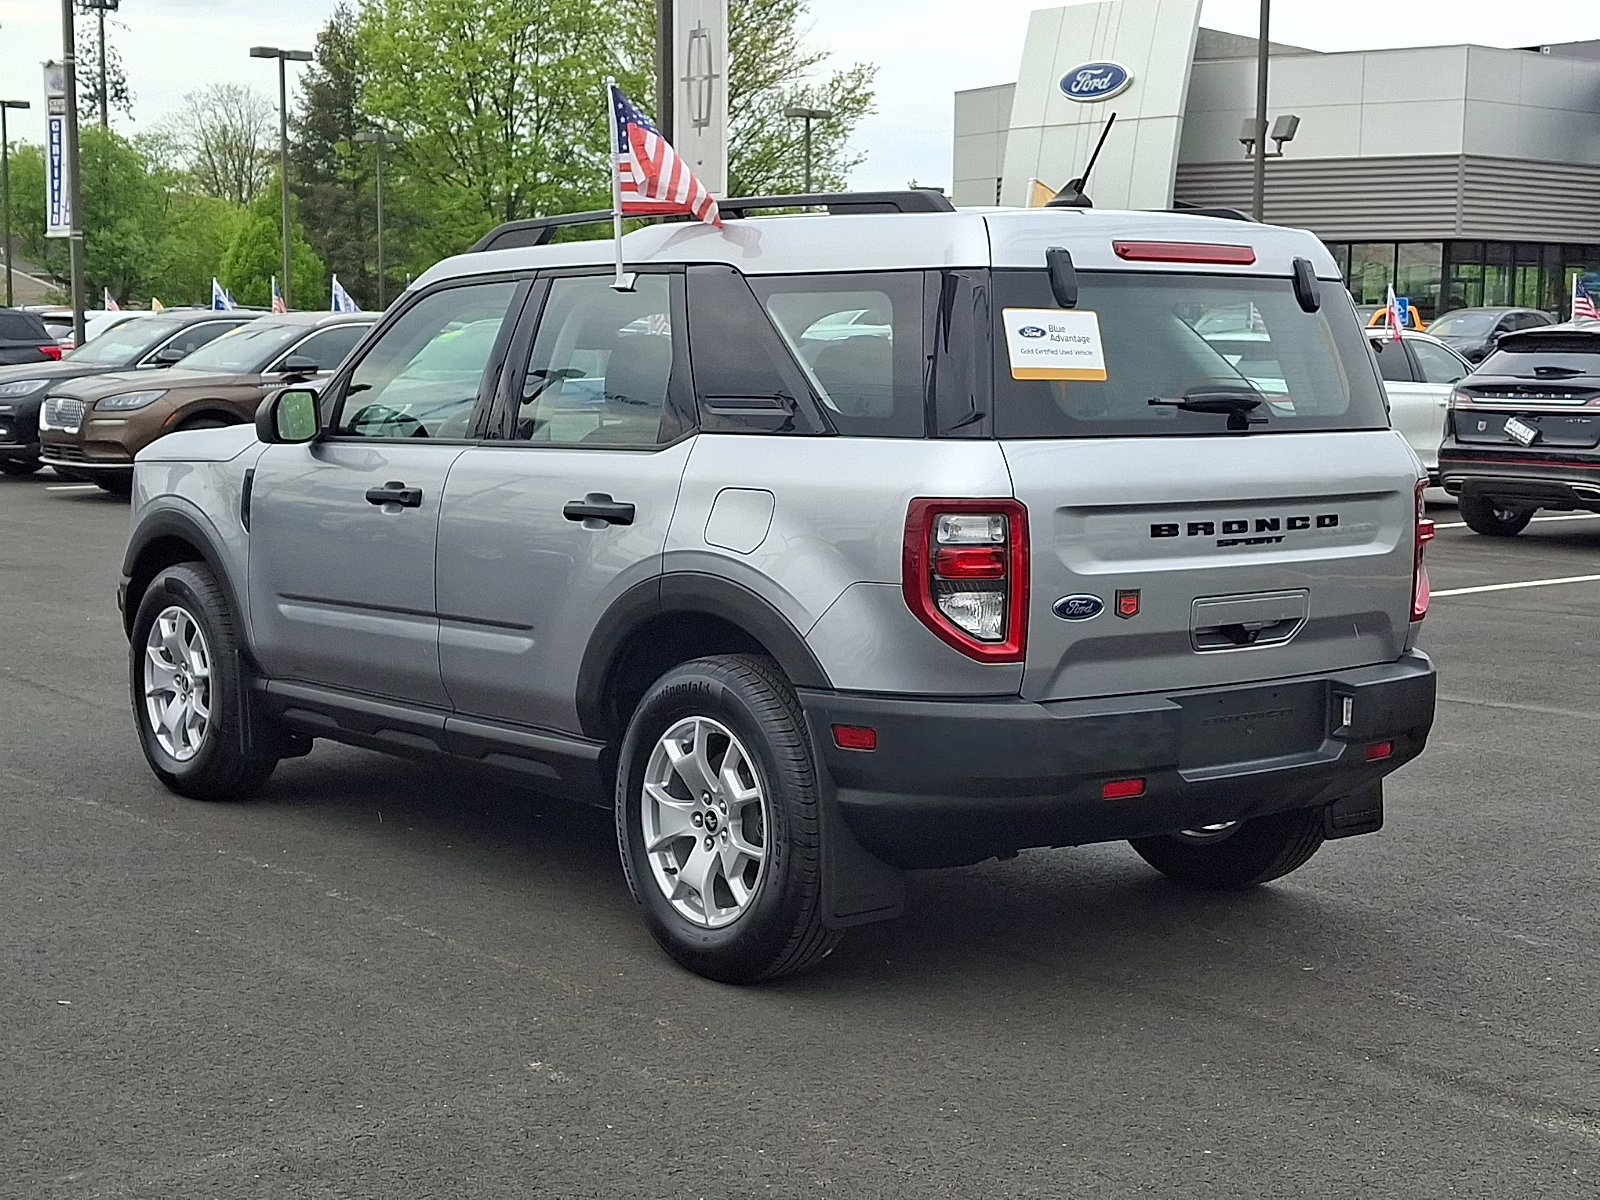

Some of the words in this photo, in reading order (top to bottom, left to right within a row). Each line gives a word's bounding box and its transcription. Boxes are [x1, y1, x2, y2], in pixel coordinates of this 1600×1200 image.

[1071, 68, 1114, 93] Ford
[51, 121, 60, 224] CERTIFIED
[1048, 324, 1066, 333] Blue
[1050, 334, 1091, 345] Advantage
[1150, 513, 1339, 538] BRONCO
[1216, 535, 1286, 548] SPORT
[1065, 600, 1093, 615] Ford
